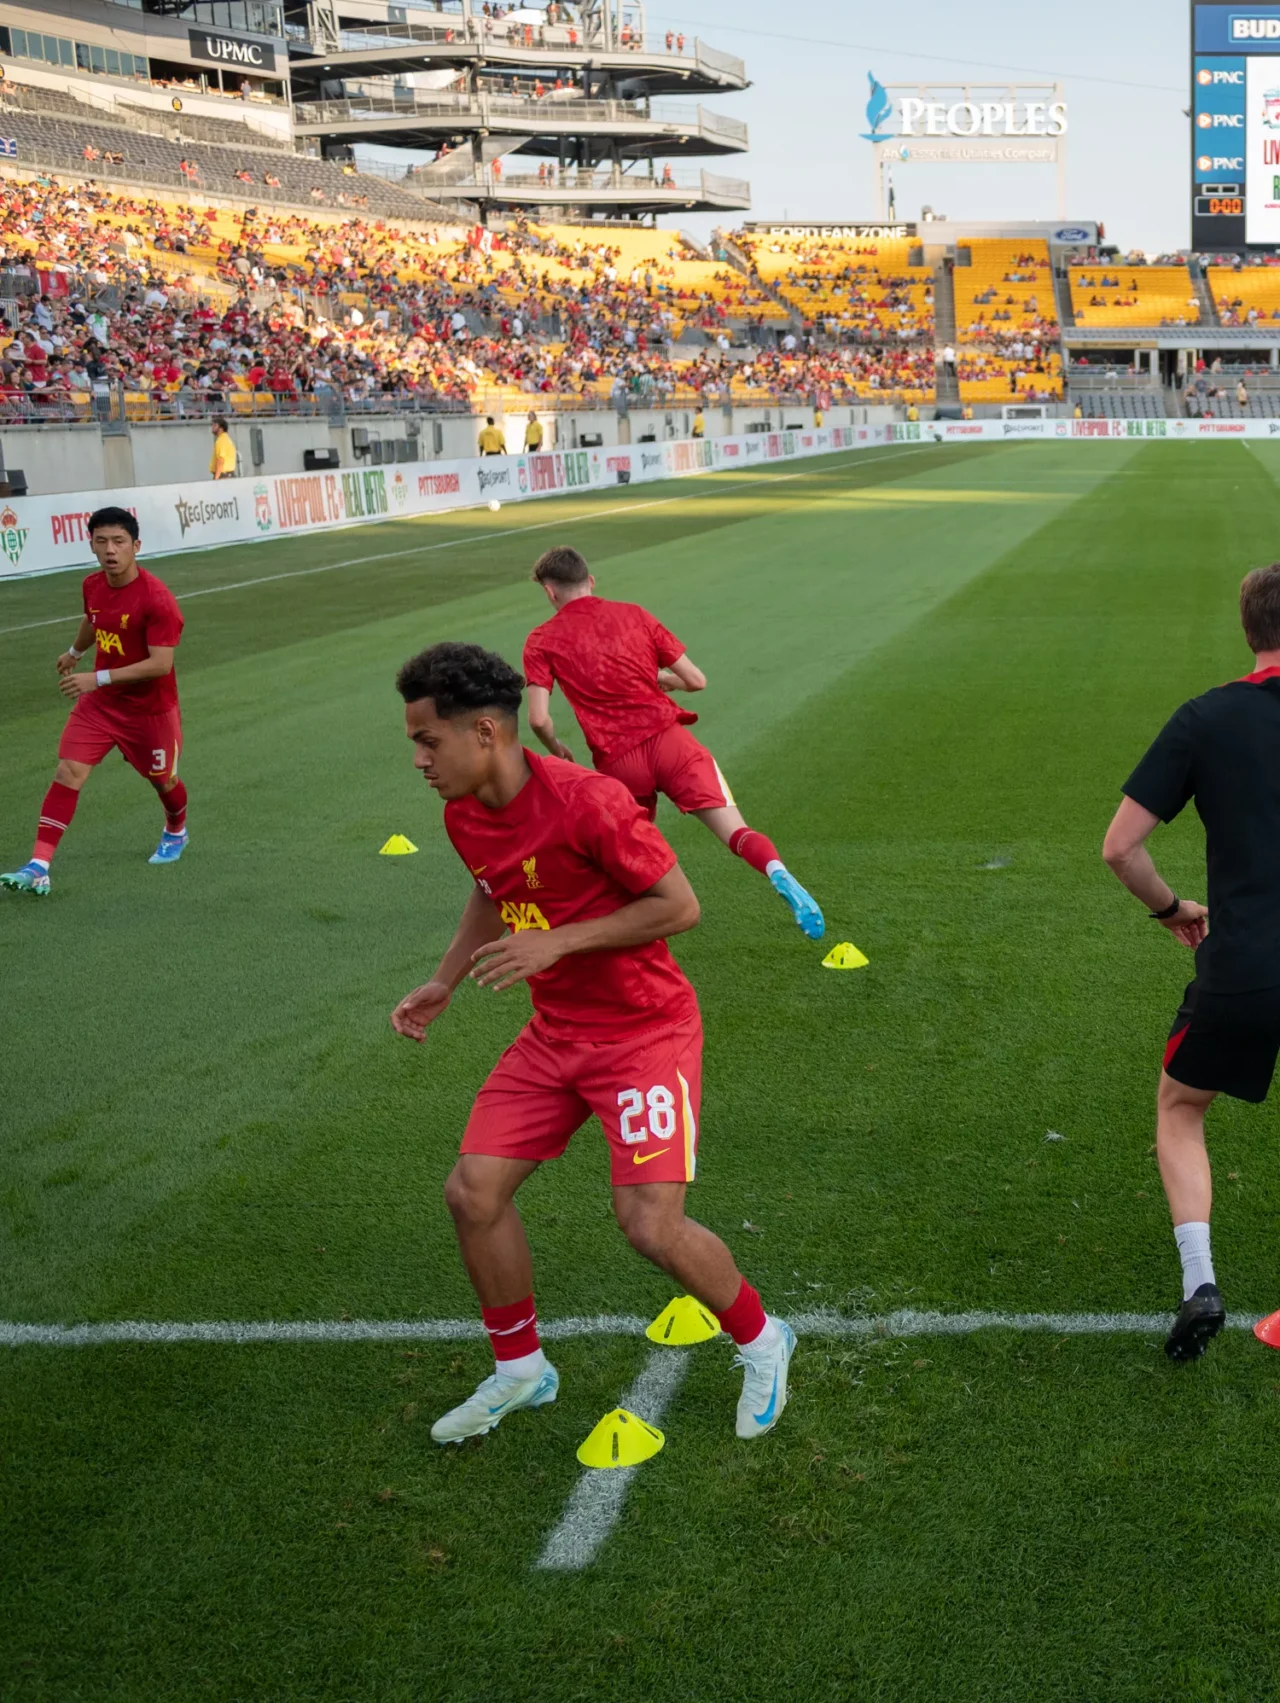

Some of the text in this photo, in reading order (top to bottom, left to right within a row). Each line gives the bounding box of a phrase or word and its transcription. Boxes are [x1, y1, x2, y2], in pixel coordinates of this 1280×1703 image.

[206, 36, 263, 64] UPMC
[1213, 71, 1244, 84] PNC
[897, 97, 1069, 136] PEOPLES
[1213, 114, 1244, 128] PNC
[1213, 156, 1244, 170] PNC
[770, 226, 821, 238] FORD
[821, 226, 856, 238] FAN
[1071, 420, 1167, 437] LIVERPOOL FC REAL BETIS
[1199, 423, 1246, 433] PITTSBURGH
[418, 472, 460, 497] PITTSBURGH
[274, 475, 327, 529] LIVERPOOL
[325, 474, 340, 521] FC
[341, 471, 365, 519] REAL
[363, 469, 389, 516] BETIS
[95, 628, 126, 656] AXA
[152, 749, 166, 770] 3
[501, 900, 551, 934] AXA
[617, 1085, 677, 1145] 28
